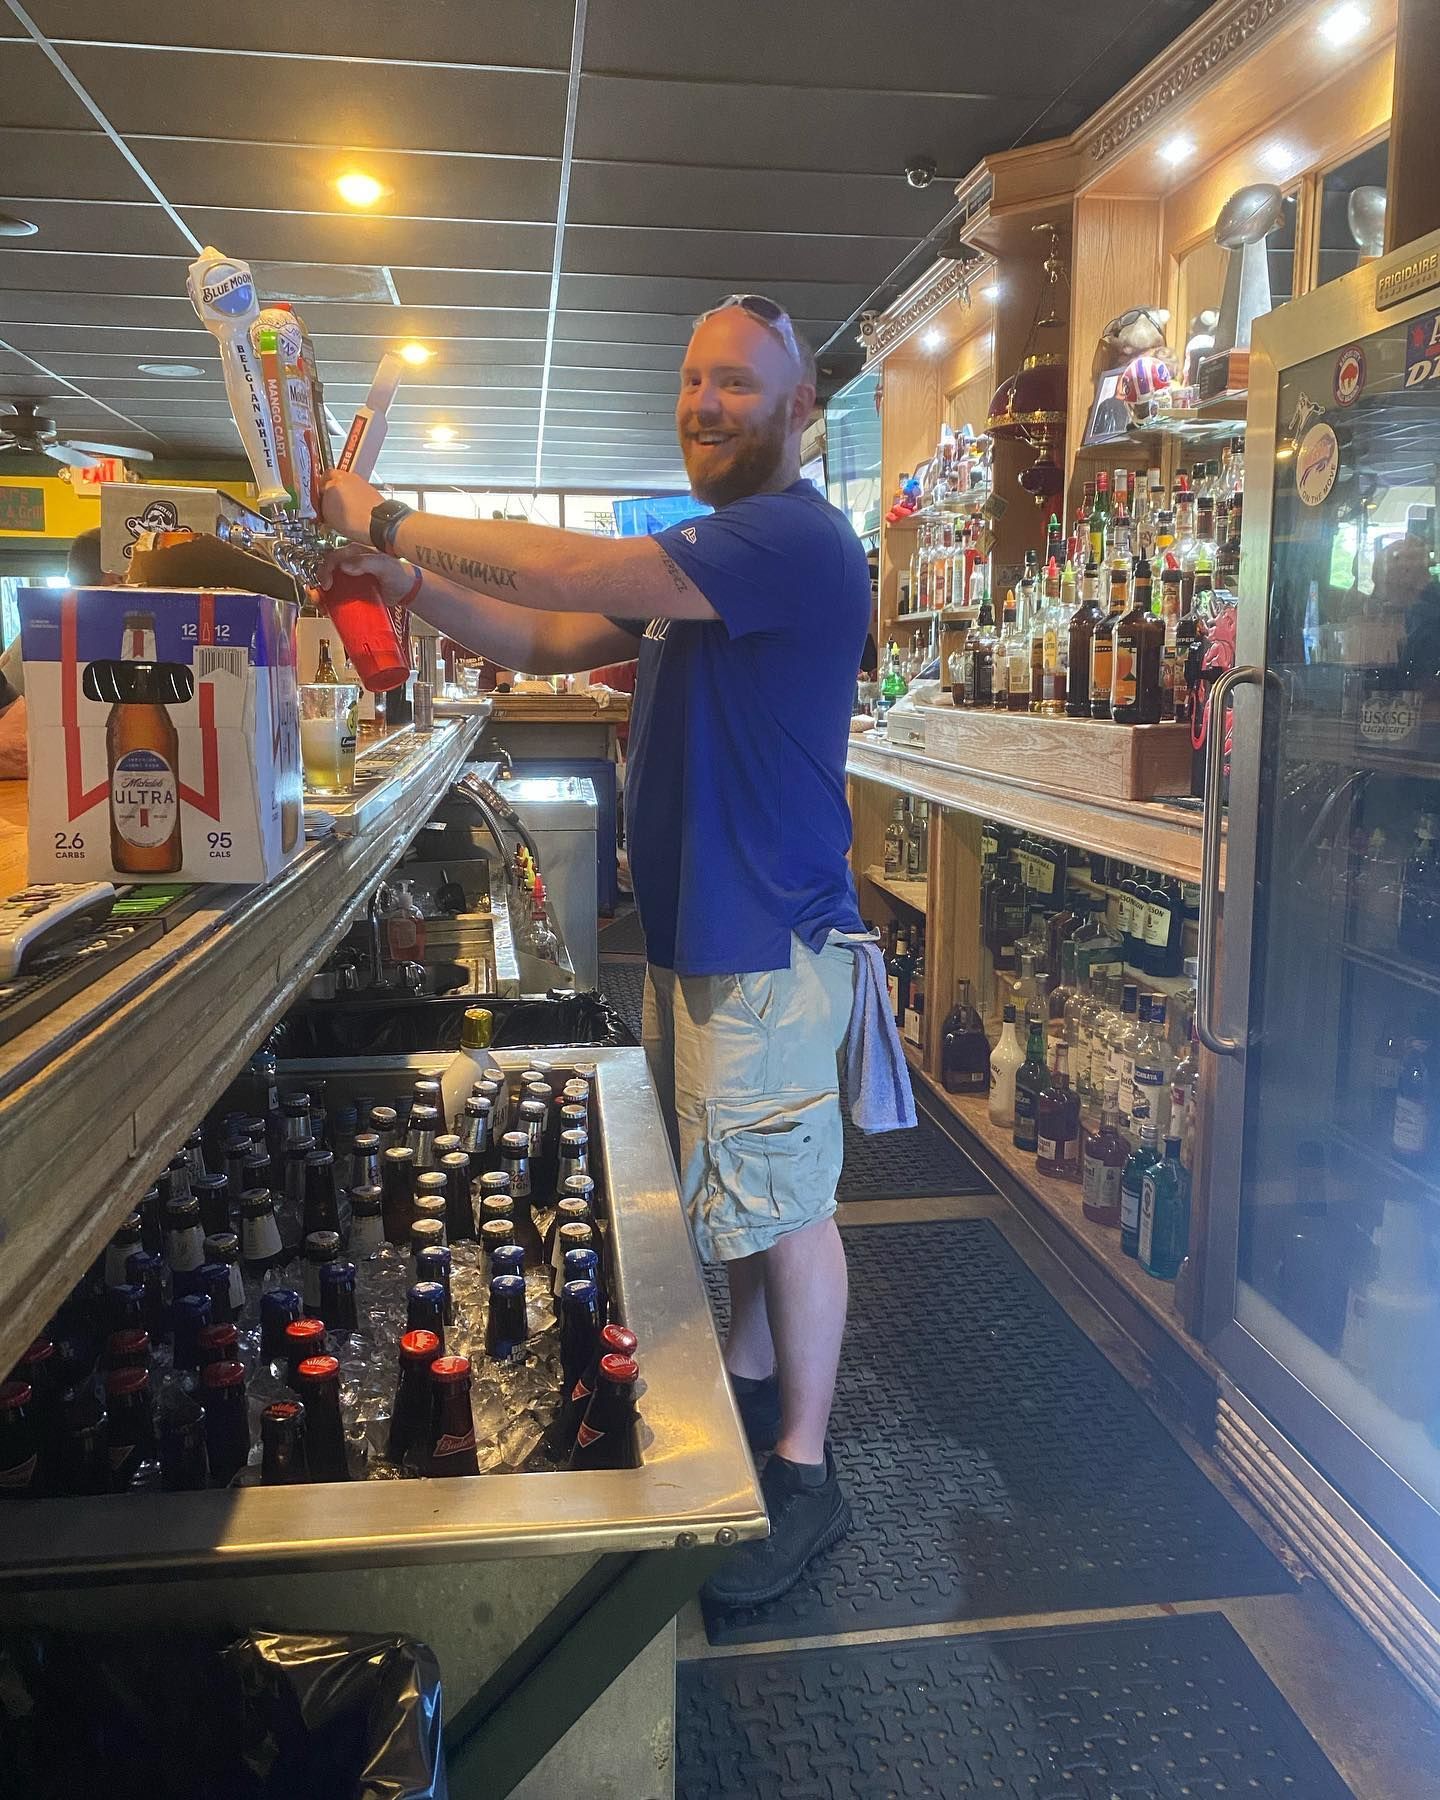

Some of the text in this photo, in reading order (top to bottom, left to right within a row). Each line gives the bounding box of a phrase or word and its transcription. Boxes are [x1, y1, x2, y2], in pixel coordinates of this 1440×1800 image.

[1379, 254, 1438, 291] FRIGIDAIRE
[203, 273, 252, 303] BLUE MOON
[236, 345, 273, 468] BELGIAN WHITE
[267, 378, 287, 458] MANGO CART
[83, 460, 115, 483] EXIT
[1302, 463, 1336, 503] ON THE MOVE
[181, 623, 197, 636] 12
[214, 624, 230, 637] 12
[115, 790, 174, 805] ULTRA
[55, 833, 85, 849] 2.6
[207, 832, 233, 849] 95
[55, 851, 86, 859] CARBS
